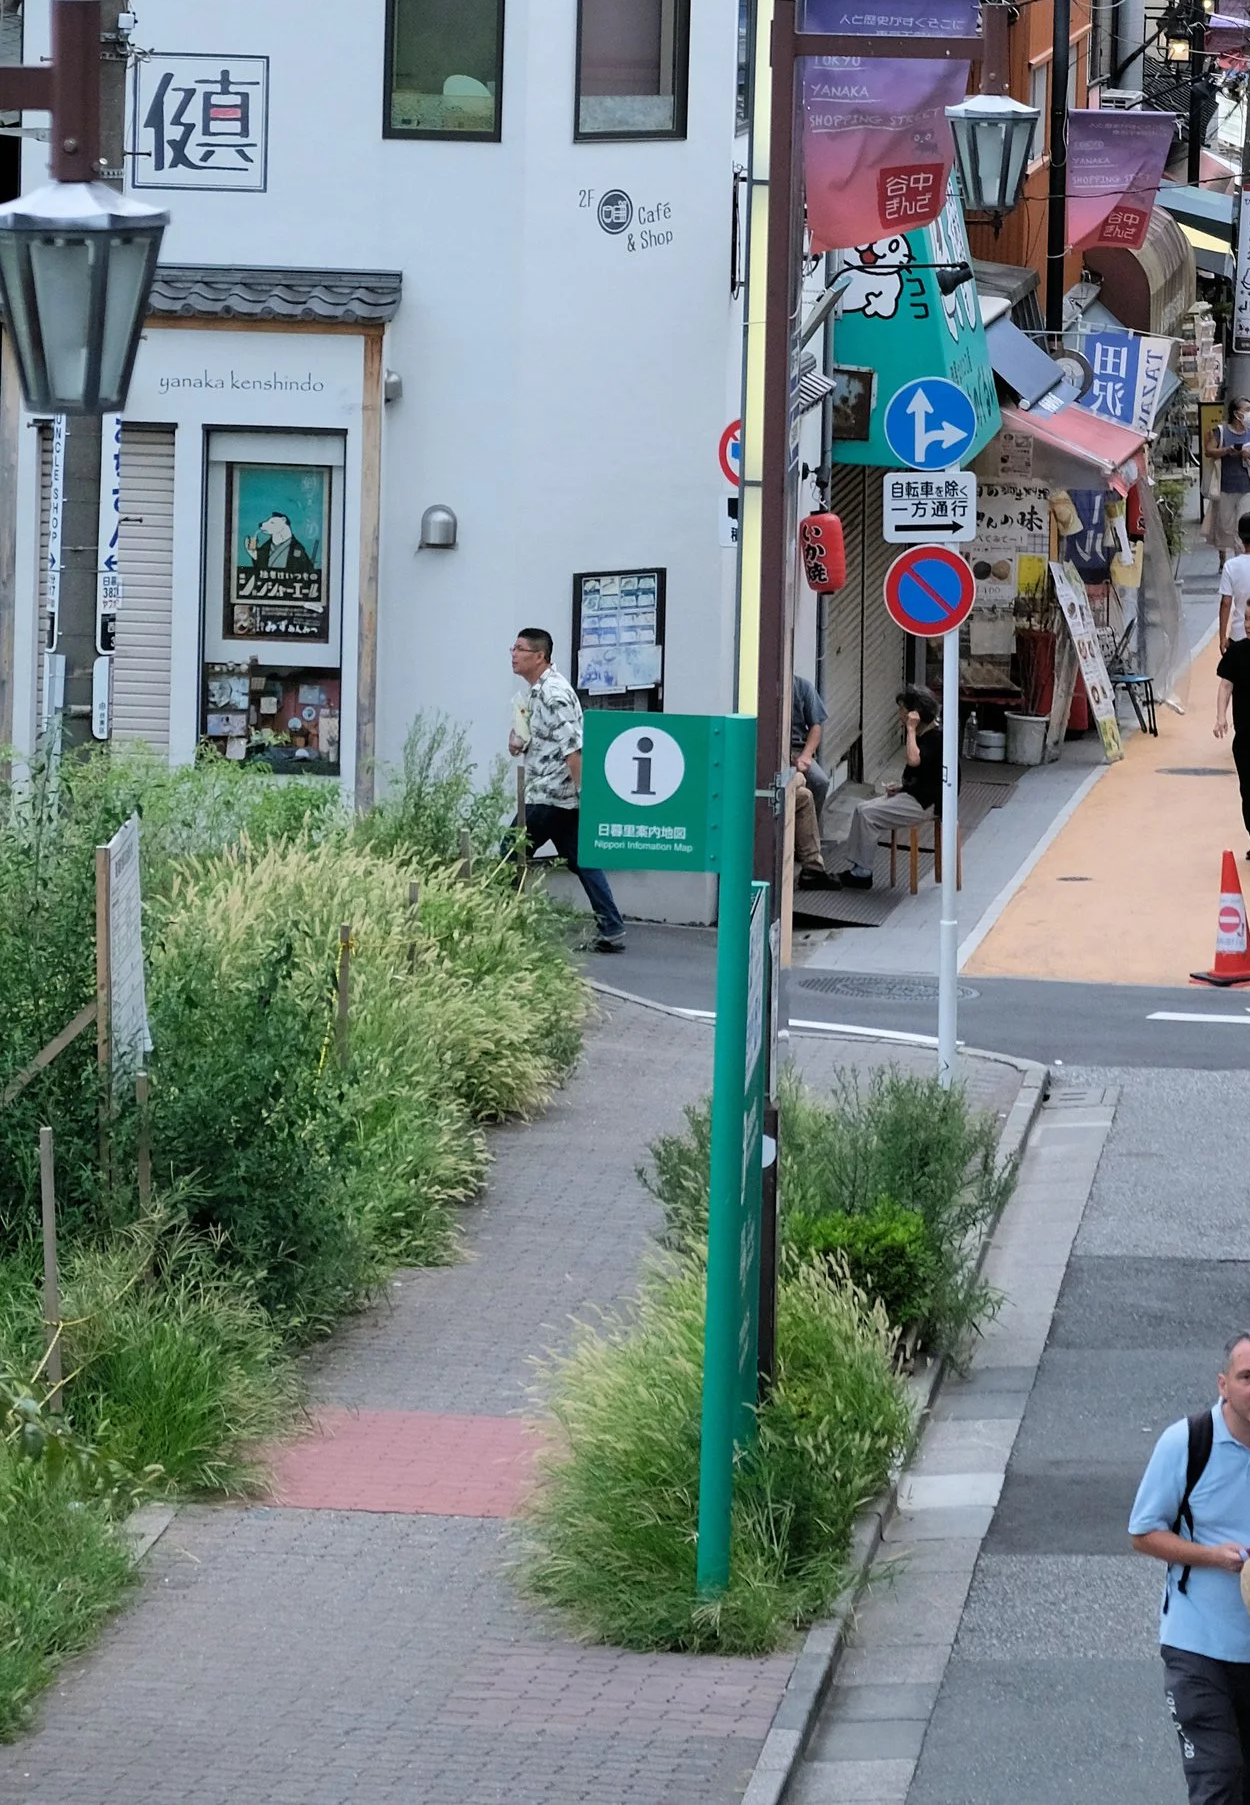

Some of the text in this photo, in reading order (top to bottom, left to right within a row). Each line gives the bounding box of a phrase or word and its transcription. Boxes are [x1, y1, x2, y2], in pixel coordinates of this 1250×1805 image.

[811, 83, 869, 97] YANAKA
[809, 113, 883, 127] SHOPPING
[1071, 157, 1111, 165] YANAKA
[886, 172, 933, 196] 谷中
[578, 189, 595, 208] 2F
[885, 192, 933, 220] ぎんざ
[637, 201, 672, 225] Café
[626, 229, 674, 253] & Shop
[158, 369, 325, 395] yanaka kenshindo
[891, 480, 969, 499] 自転車を除く
[51, 487, 60, 544] SHOP
[890, 501, 969, 519] 一方通行
[801, 521, 829, 584] いか焼
[598, 823, 687, 840] 日暮里案内地図
[594, 839, 626, 850] Nippori
[673, 843, 693, 854] Map
